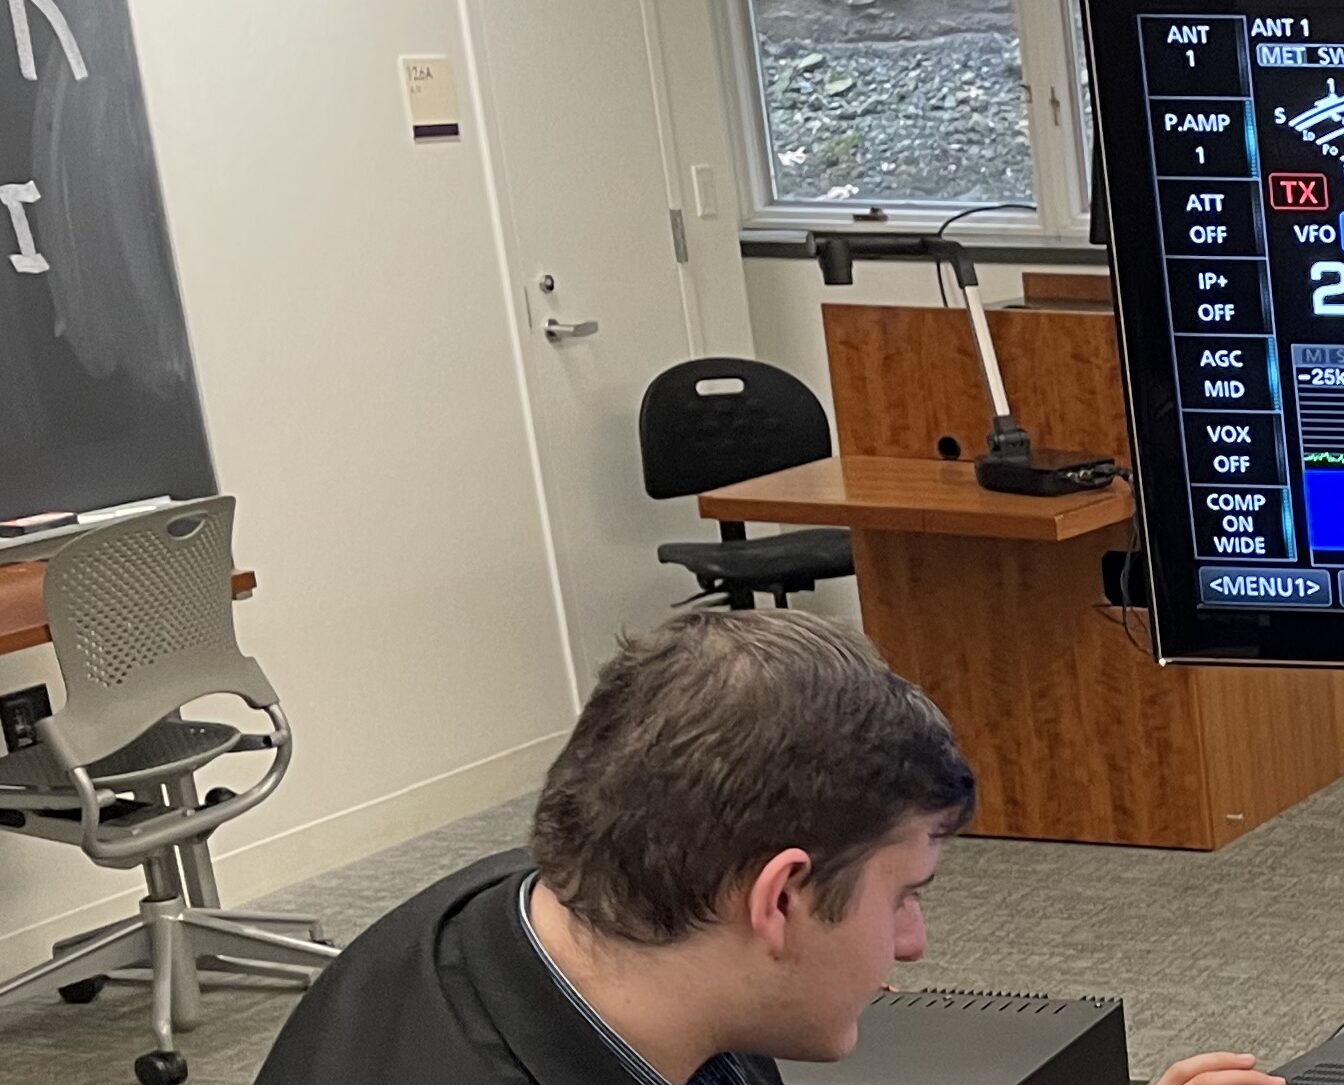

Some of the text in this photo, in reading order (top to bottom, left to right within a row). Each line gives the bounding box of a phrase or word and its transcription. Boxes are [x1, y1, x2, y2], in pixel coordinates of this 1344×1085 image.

[1167, 27, 1210, 44] ANT
[1251, 19, 1309, 37] ANT 1
[1186, 51, 1194, 66] 1
[1261, 47, 1306, 64] MET
[1165, 115, 1230, 132] P.AMP
[1196, 148, 1204, 164] 1
[1280, 181, 1316, 204] TX
[1186, 195, 1224, 212] ATT
[1190, 226, 1227, 243] OFF
[1294, 225, 1336, 243] VFO
[1199, 273, 1228, 290] IP+
[1199, 305, 1235, 321] OFF
[1201, 350, 1243, 368] AGC
[1205, 381, 1245, 398] MID
[1207, 425, 1251, 443] VOX
[1214, 456, 1250, 473] OFF
[1207, 494, 1265, 511] COMP
[1222, 516, 1253, 532] ON
[1214, 537, 1265, 555] WIDE
[1210, 577, 1320, 599] <MENU1>
